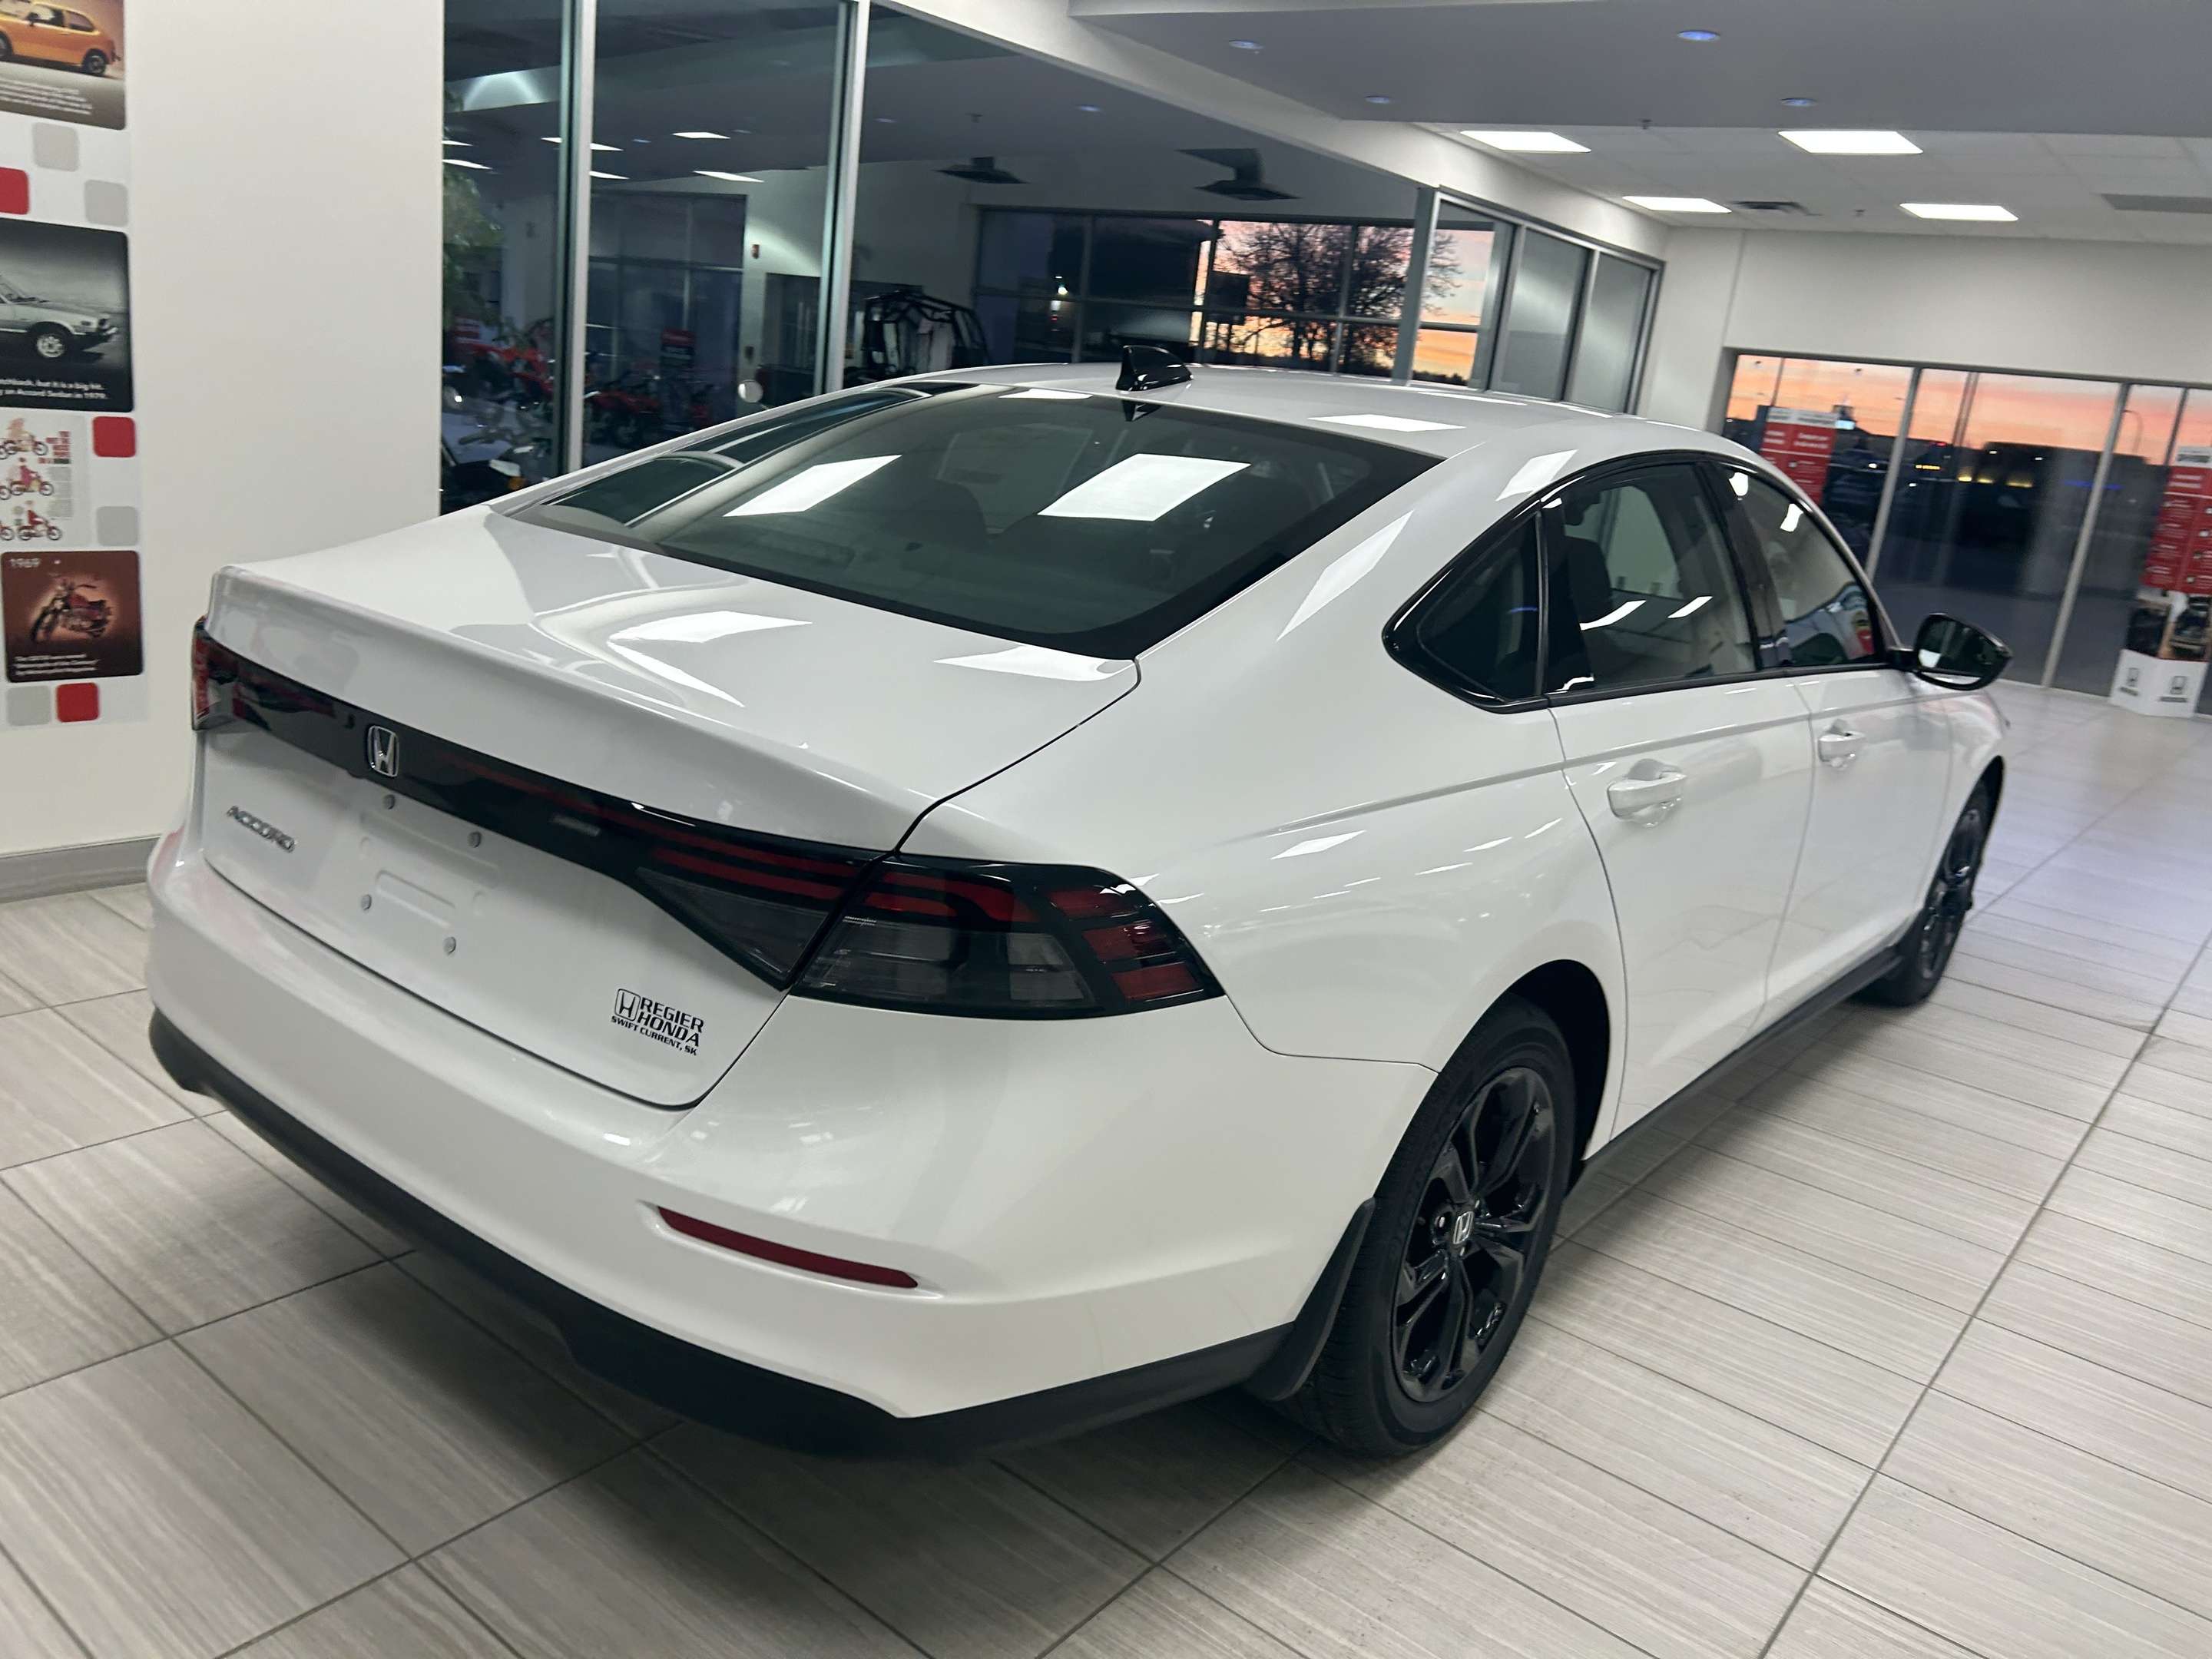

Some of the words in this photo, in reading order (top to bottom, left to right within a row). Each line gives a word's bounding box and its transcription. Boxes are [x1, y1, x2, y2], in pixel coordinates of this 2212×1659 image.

[227, 805, 296, 853] ACCORD
[637, 1011, 700, 1047] HONDA
[640, 997, 704, 1033] REGIER
[611, 1015, 638, 1031] SWIFT
[639, 1027, 683, 1051] CURRENT,
[684, 1045, 697, 1056] SK
